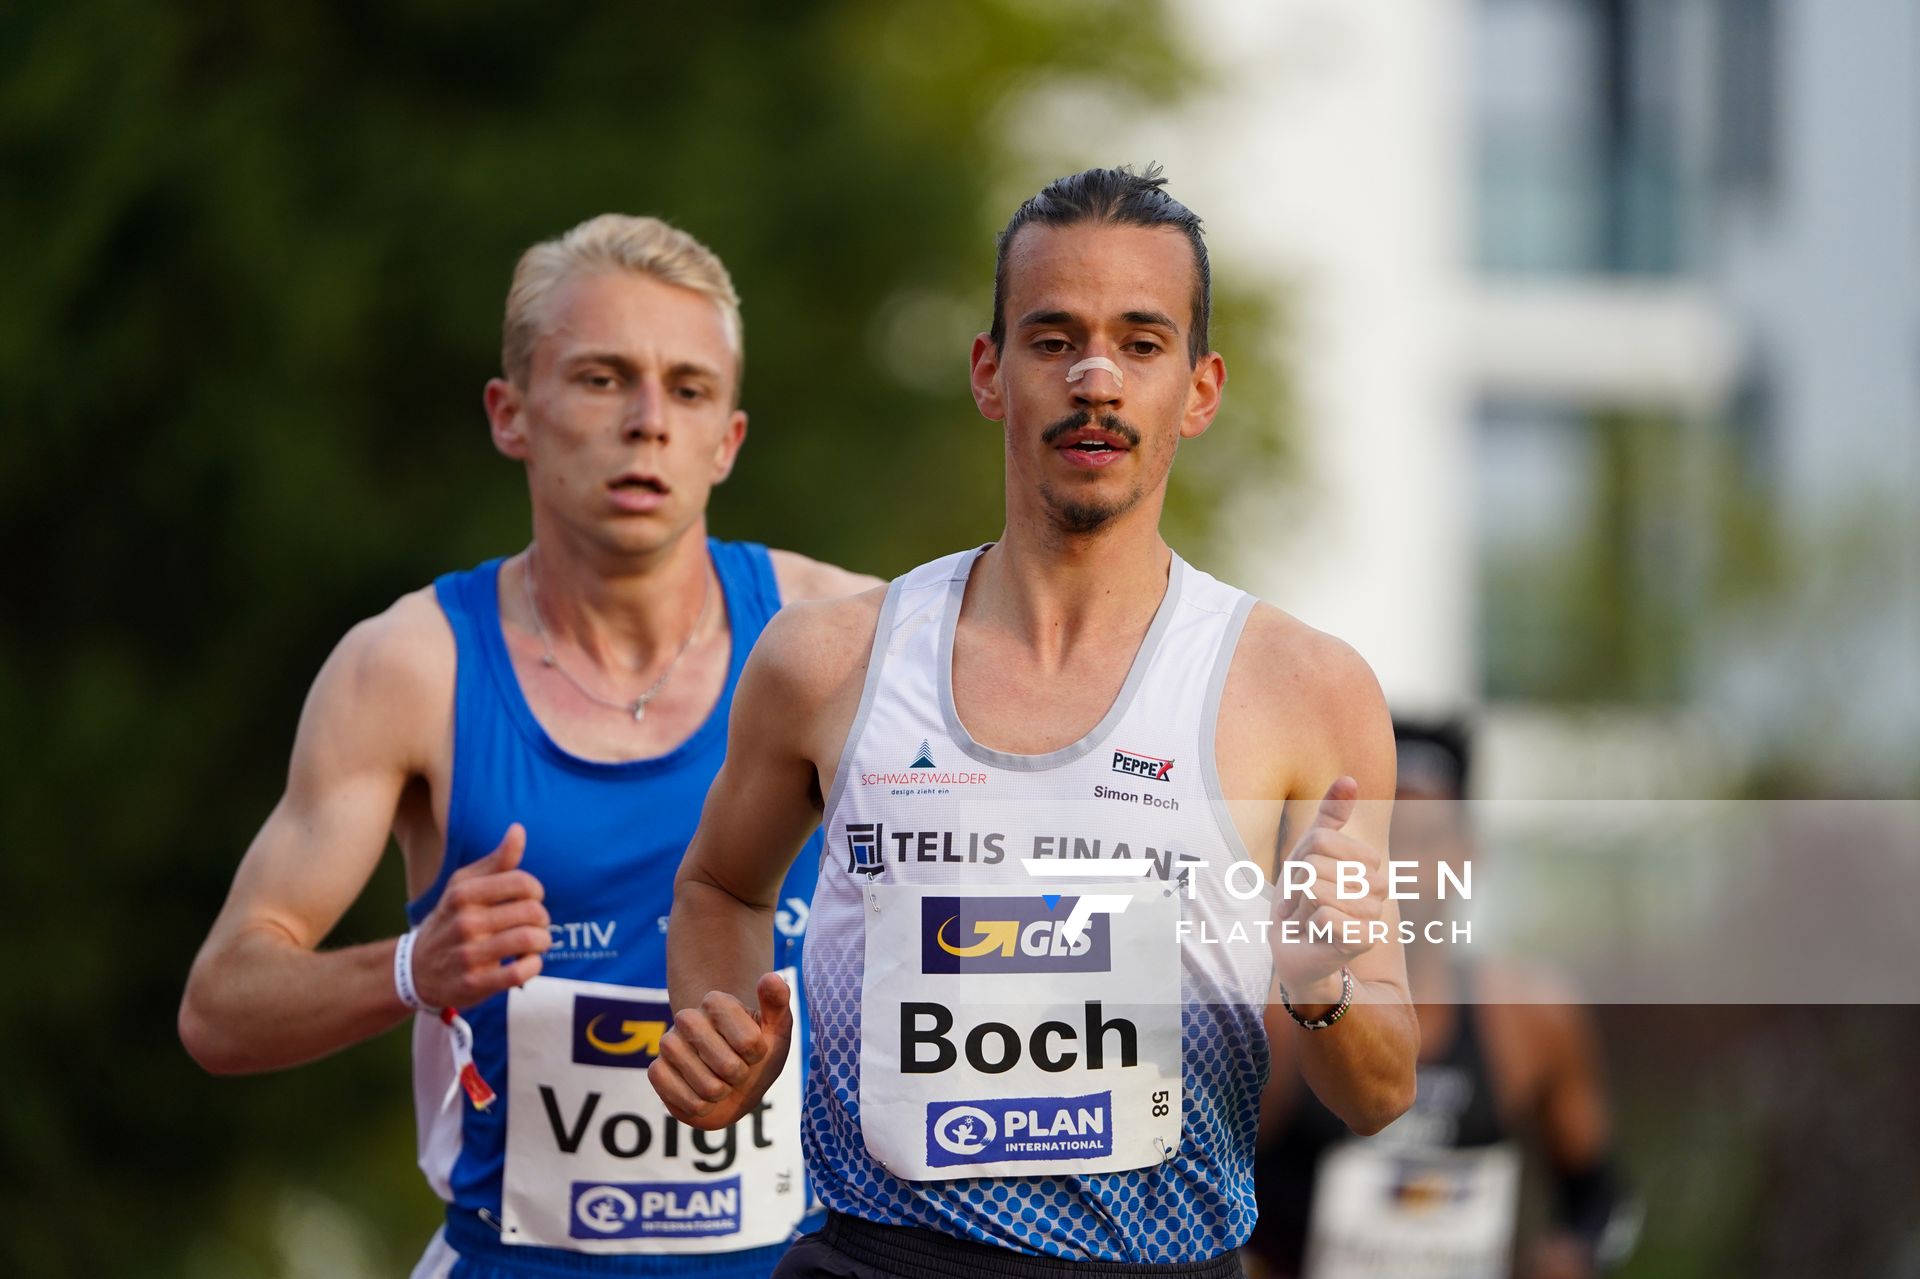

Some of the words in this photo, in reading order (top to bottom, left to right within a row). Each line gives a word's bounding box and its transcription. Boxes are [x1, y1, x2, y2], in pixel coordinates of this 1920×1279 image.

[1112, 751, 1173, 781] PEPPEX
[1094, 785, 1138, 803] Simon
[1143, 793, 1179, 811] Boch
[892, 831, 1006, 865] TELIS
[1020, 920, 1093, 957] GLS
[900, 1000, 1138, 1074] Boch
[1152, 1090, 1169, 1117] 58
[539, 1085, 773, 1173] Voigt
[1004, 1107, 1104, 1137] PLAN
[1005, 1139, 1104, 1153] INTERNATIONAL
[641, 1187, 737, 1218] PLAN
[641, 1218, 737, 1233] INTERNATIONAL
